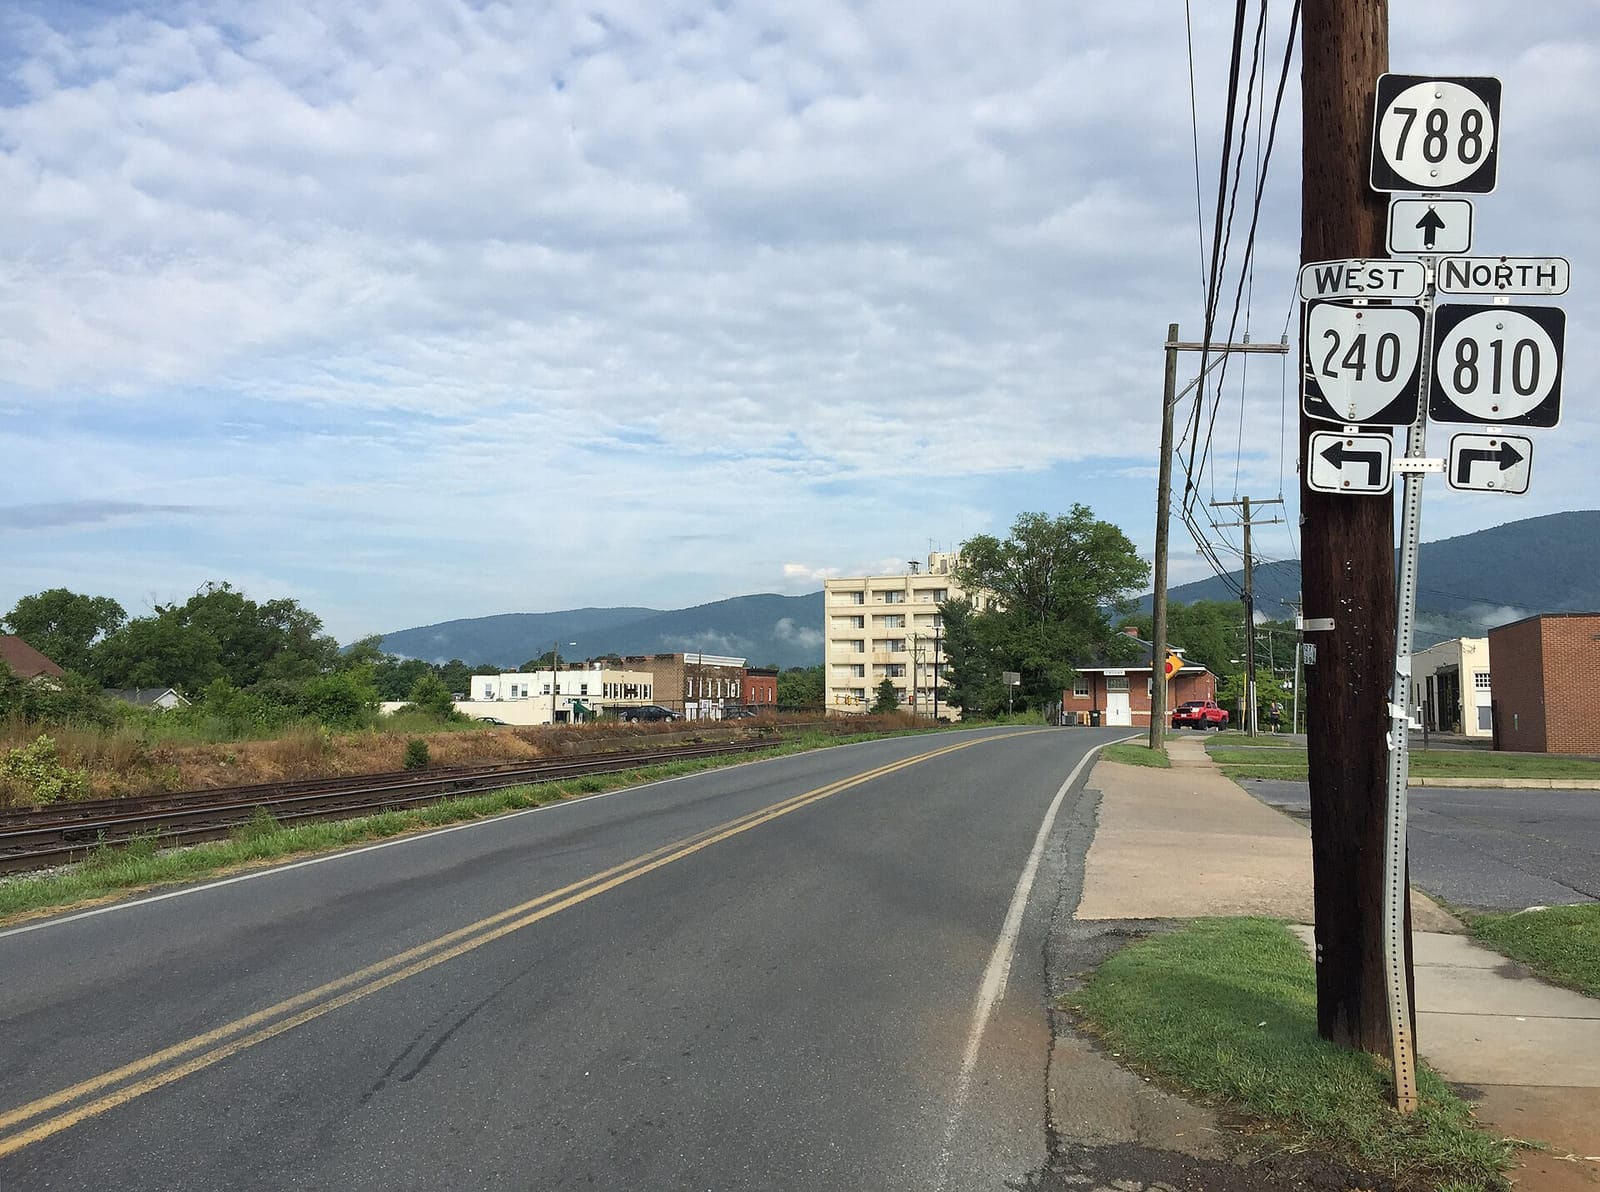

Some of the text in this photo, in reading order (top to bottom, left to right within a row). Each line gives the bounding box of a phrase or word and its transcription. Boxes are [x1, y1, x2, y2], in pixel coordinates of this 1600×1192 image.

[1393, 107, 1483, 164] 788
[1315, 265, 1404, 294] WEST
[1446, 261, 1556, 289] NORTH
[1322, 329, 1401, 382] 240
[1453, 337, 1541, 395] 810
